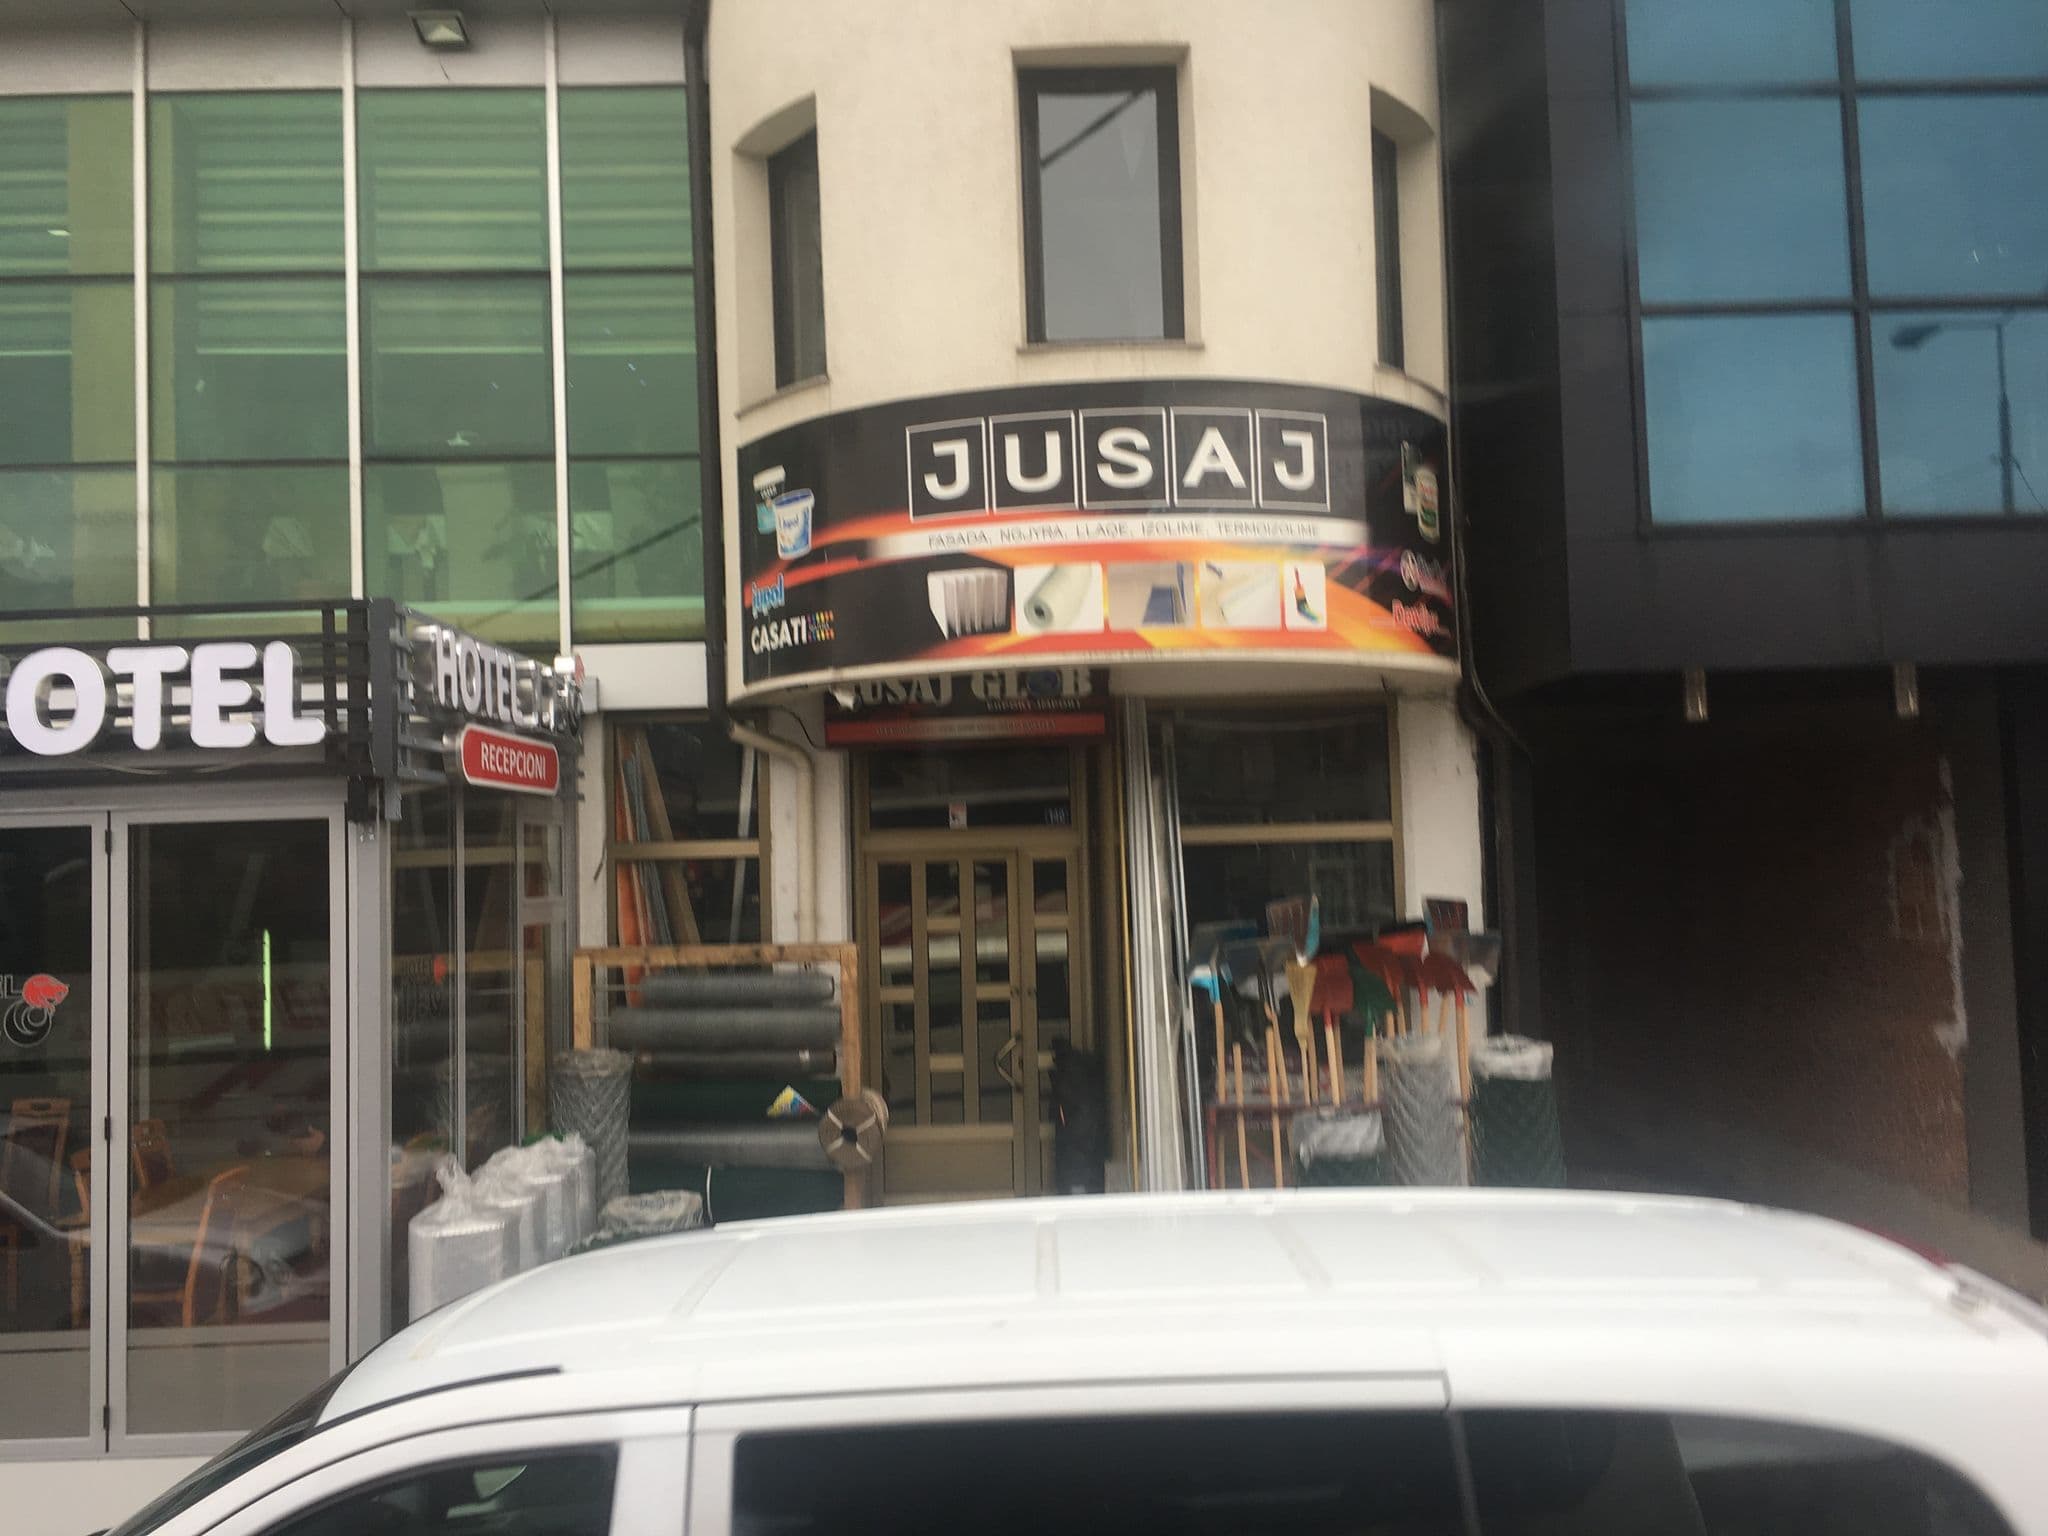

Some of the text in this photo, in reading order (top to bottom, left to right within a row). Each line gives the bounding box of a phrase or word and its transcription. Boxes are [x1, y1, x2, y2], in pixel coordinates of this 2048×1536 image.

[923, 425, 1316, 501] JUSAJ
[750, 615, 808, 655] CASATI
[433, 626, 524, 727] HOTEL
[480, 740, 546, 781] RECEPCIONI
